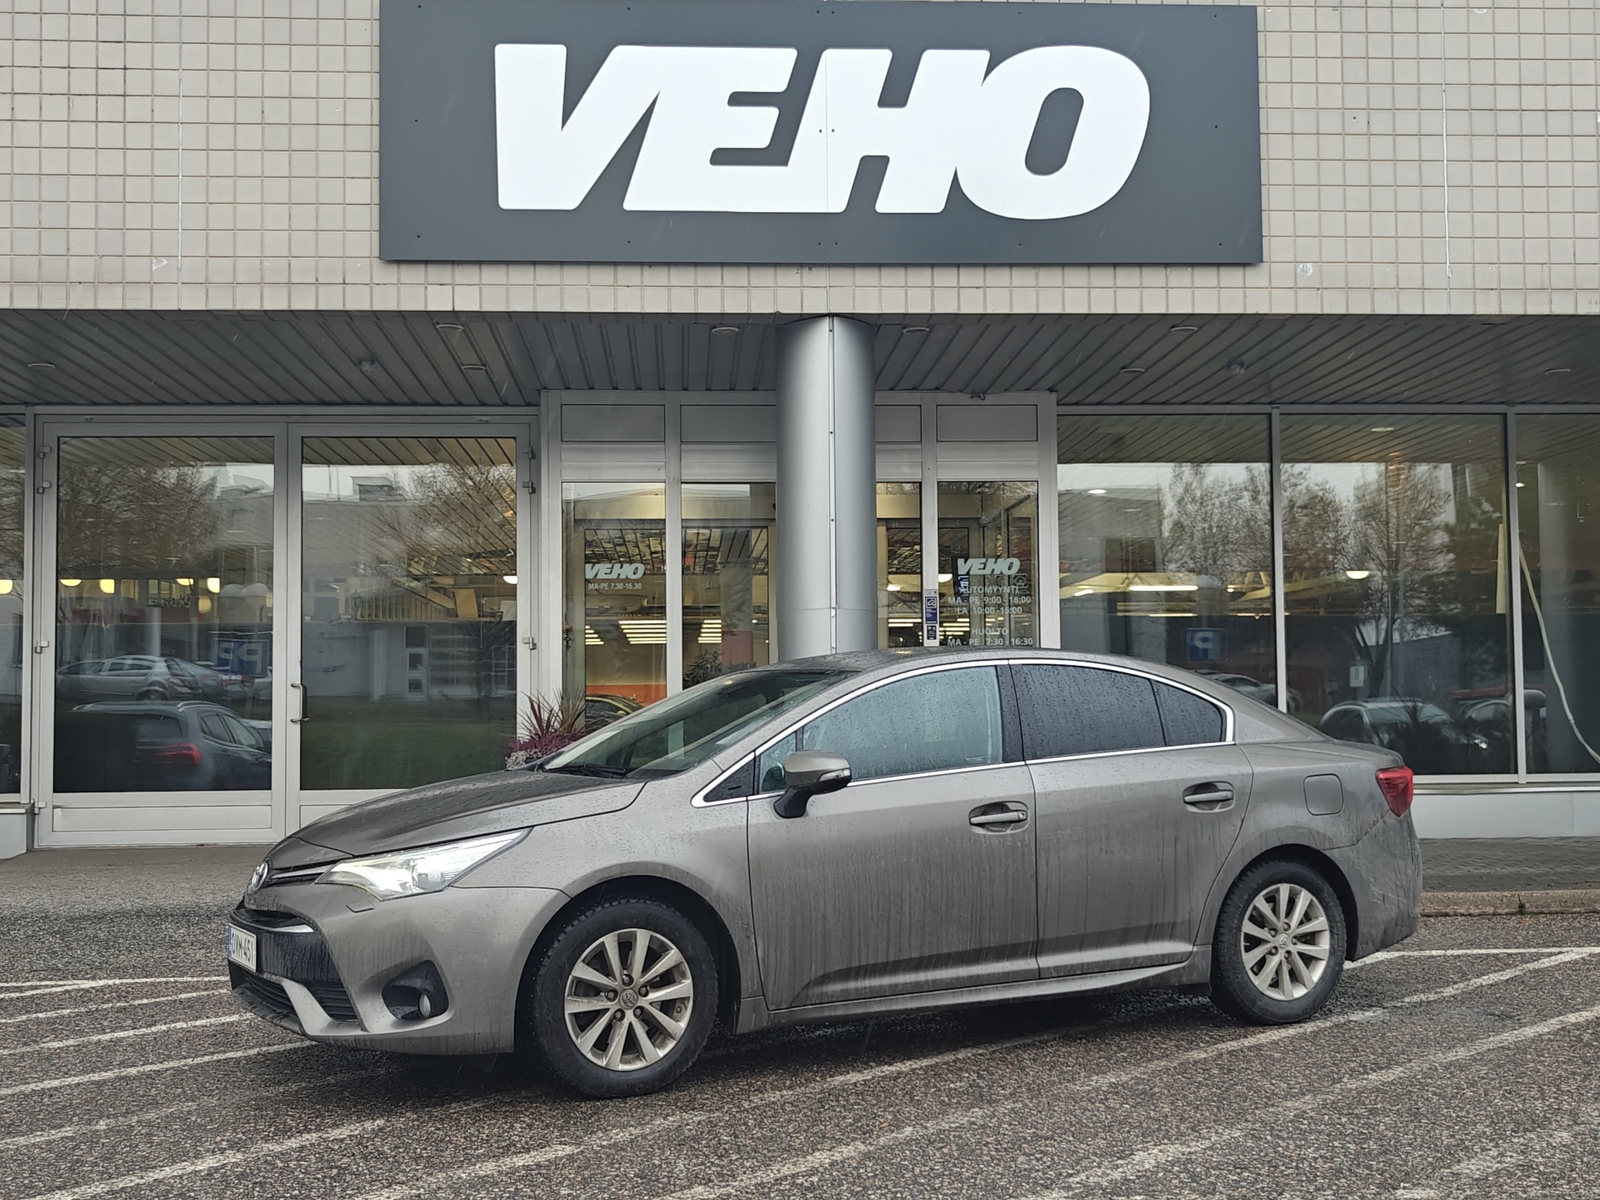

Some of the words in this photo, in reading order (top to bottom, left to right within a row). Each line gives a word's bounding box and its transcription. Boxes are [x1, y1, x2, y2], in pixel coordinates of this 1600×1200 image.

[494, 43, 1151, 221] VEHO
[957, 557, 1021, 575] VEHO
[585, 562, 646, 580] VEHO
[588, 582, 610, 590] MA-PE
[610, 582, 643, 590] 7.30-16.30
[960, 585, 1019, 594] AUTOMYYNTI
[947, 596, 963, 604] MA
[969, 596, 980, 604] PE
[983, 596, 1002, 604] 9:00
[1009, 595, 1032, 604] 18:00
[971, 628, 1009, 636] HUOLTO
[947, 638, 962, 646] MA
[968, 638, 980, 646] PE
[986, 638, 1004, 646] 7:30
[1010, 637, 1034, 646] 16:30
